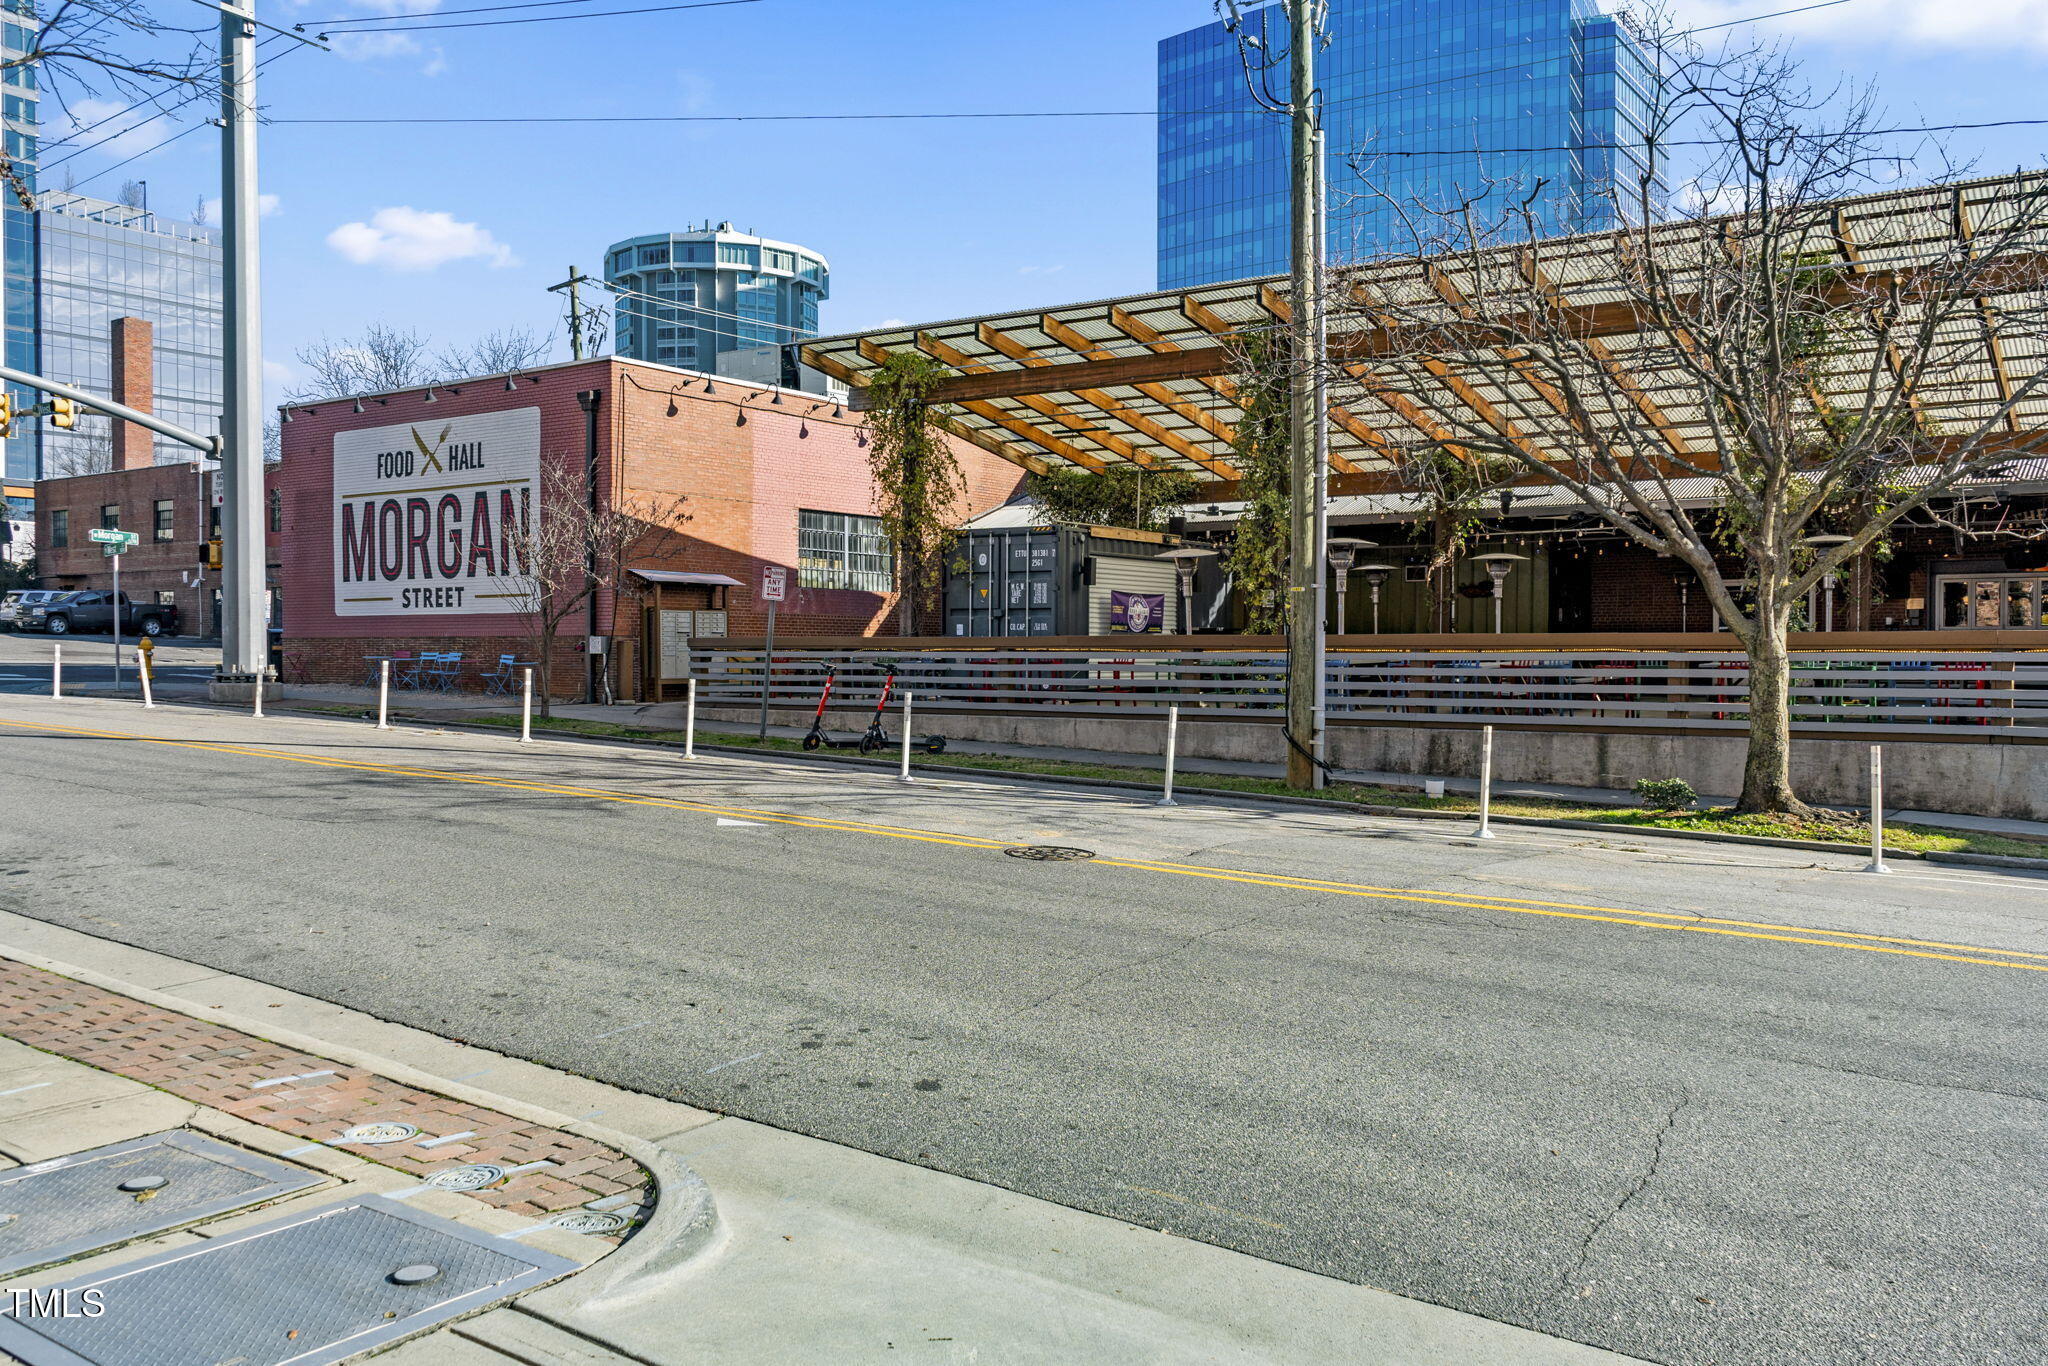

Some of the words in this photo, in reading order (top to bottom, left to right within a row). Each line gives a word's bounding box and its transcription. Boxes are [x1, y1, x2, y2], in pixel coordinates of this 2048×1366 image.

[377, 450, 414, 479] FOOD
[448, 441, 485, 472] HALL
[97, 530, 124, 542] Morgan
[342, 487, 530, 582] MORGAN
[402, 586, 465, 609] STREET
